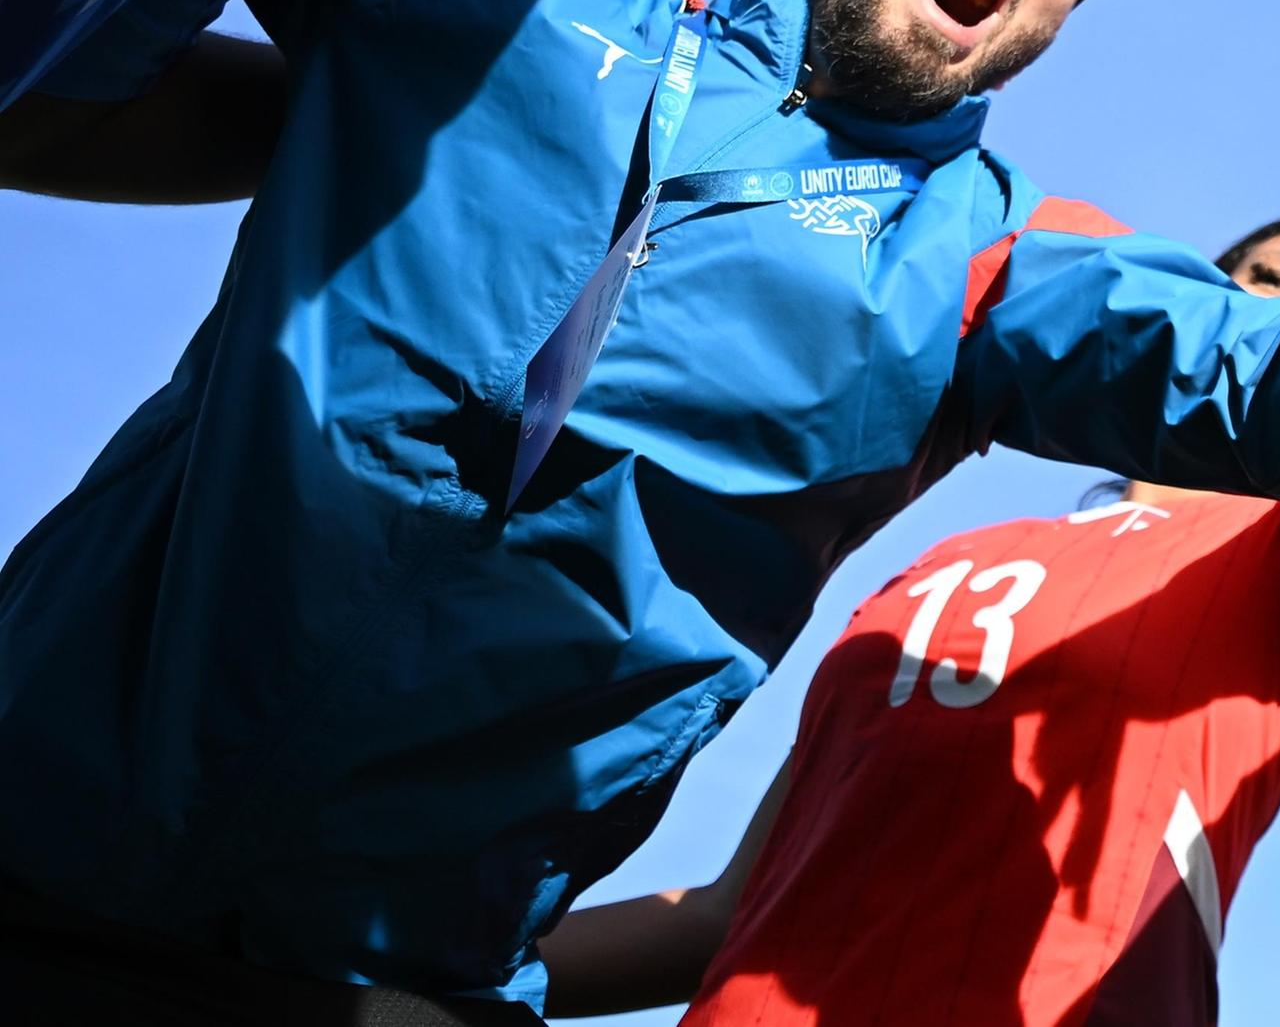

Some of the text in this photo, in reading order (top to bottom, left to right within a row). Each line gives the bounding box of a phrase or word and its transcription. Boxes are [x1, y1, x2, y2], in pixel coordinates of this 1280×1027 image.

[801, 164, 901, 194] UNITY EURO CUP
[889, 559, 1047, 708] 13
